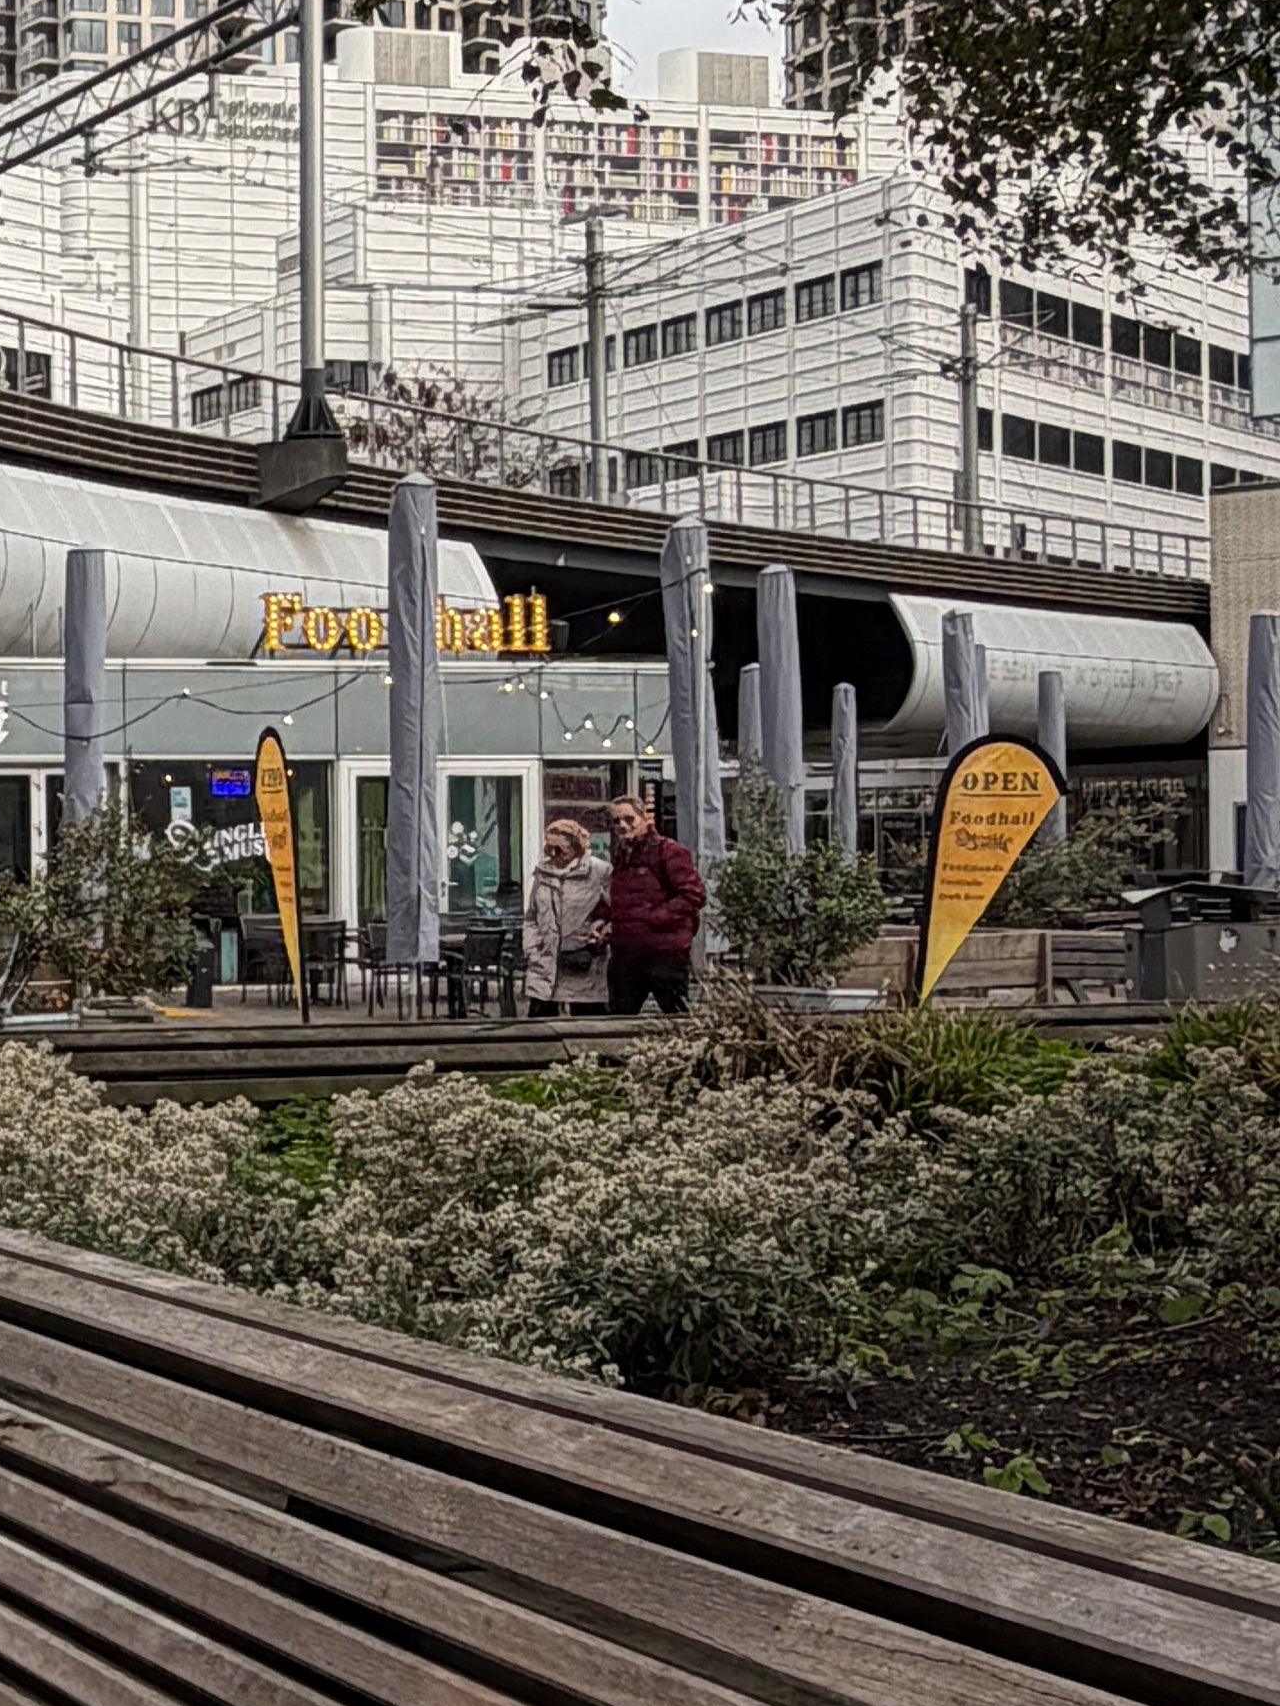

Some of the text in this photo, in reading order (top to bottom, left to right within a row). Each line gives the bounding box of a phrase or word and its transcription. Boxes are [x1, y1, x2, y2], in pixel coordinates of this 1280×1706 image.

[261, 592, 550, 652] Foohall
[960, 771, 1040, 792] OPEN
[949, 810, 1035, 826] Foodhall
[222, 838, 271, 864] MUS
